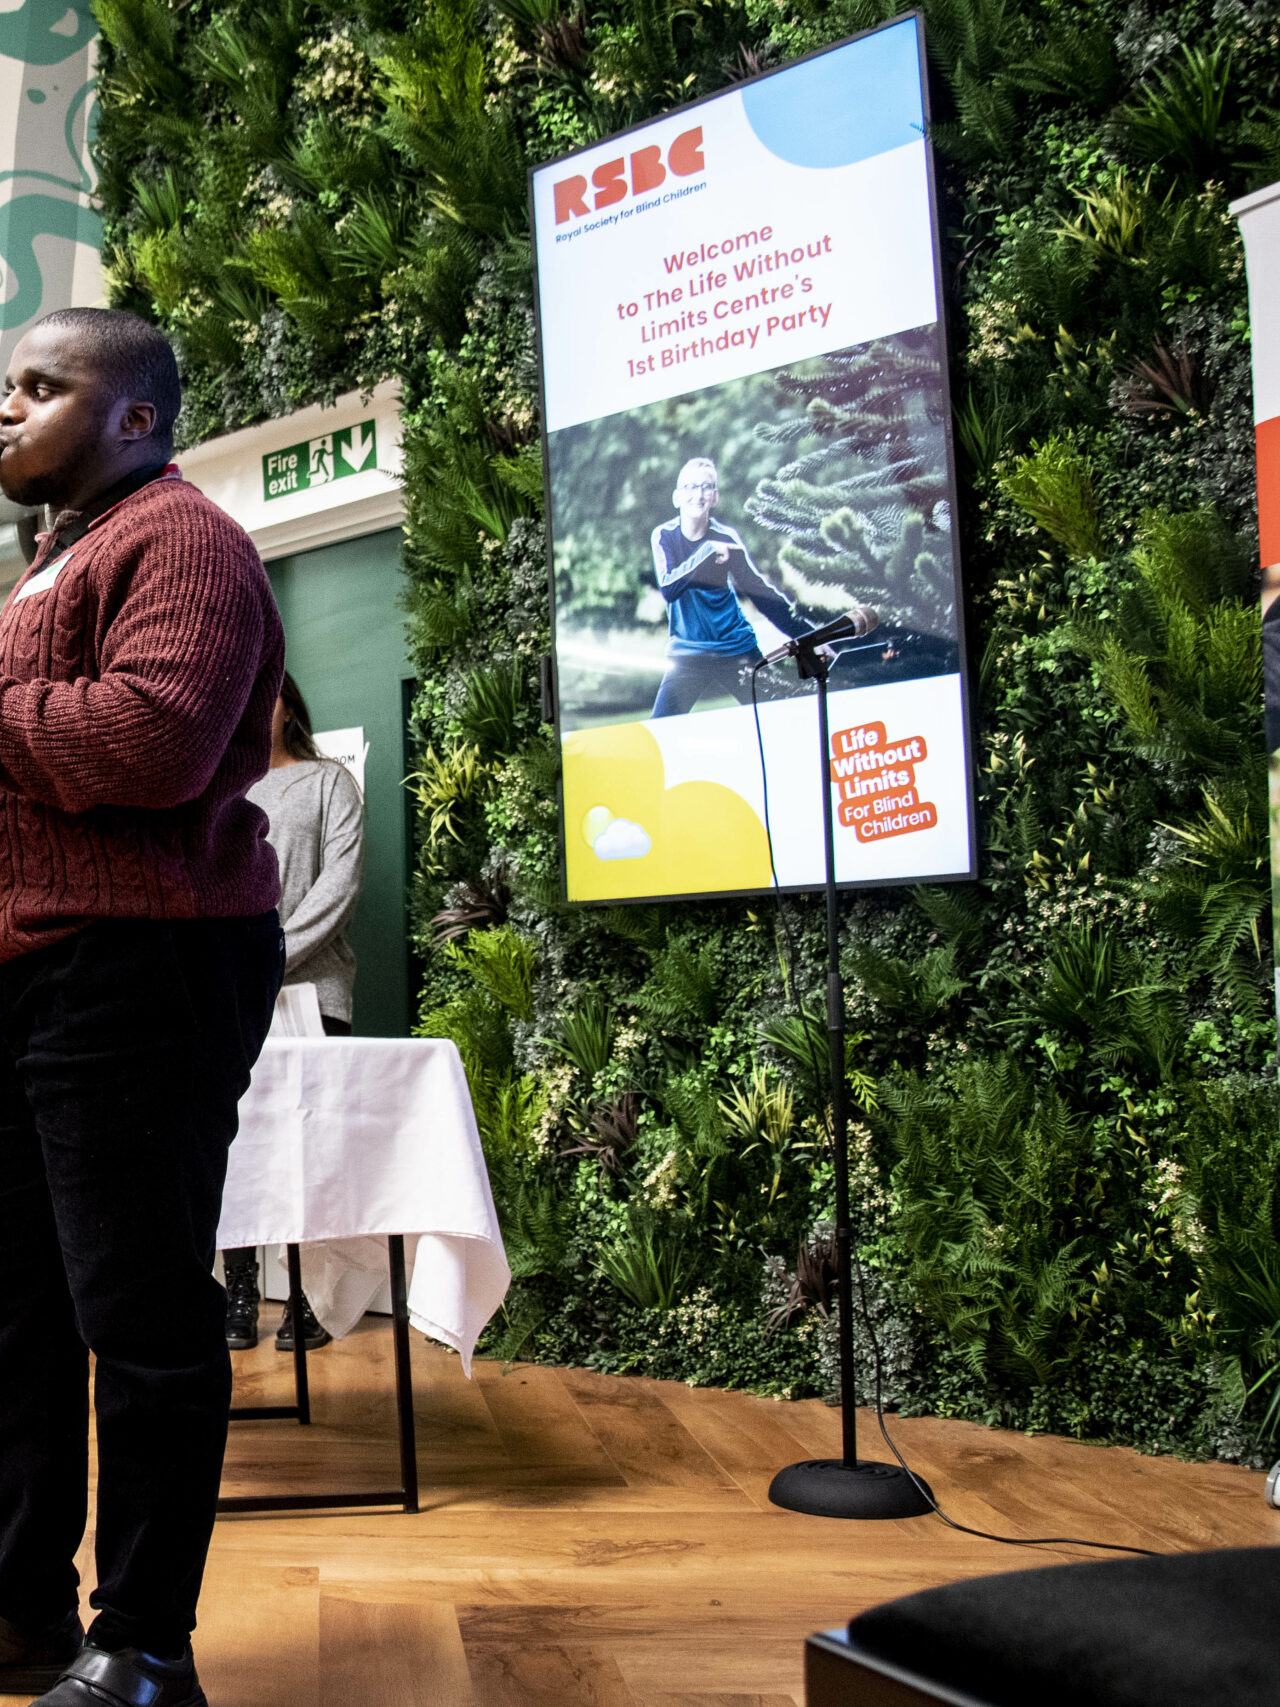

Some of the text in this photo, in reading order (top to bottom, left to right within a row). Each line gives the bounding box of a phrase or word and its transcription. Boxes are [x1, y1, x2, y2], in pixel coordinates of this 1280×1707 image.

[553, 126, 704, 225] RSBC
[556, 182, 706, 243] Royal Society for Blind Children
[664, 226, 772, 274] Welcome
[617, 235, 832, 319] to The Life Without
[642, 275, 812, 343] Limits Centre's
[628, 303, 832, 377] 1st Birthday Party
[268, 454, 297, 475] Fire
[269, 471, 297, 495] exit
[833, 740, 921, 777] Without
[841, 728, 878, 752] Life
[845, 770, 909, 799] Limits
[844, 791, 913, 823] For Blind
[861, 810, 930, 837] Children
